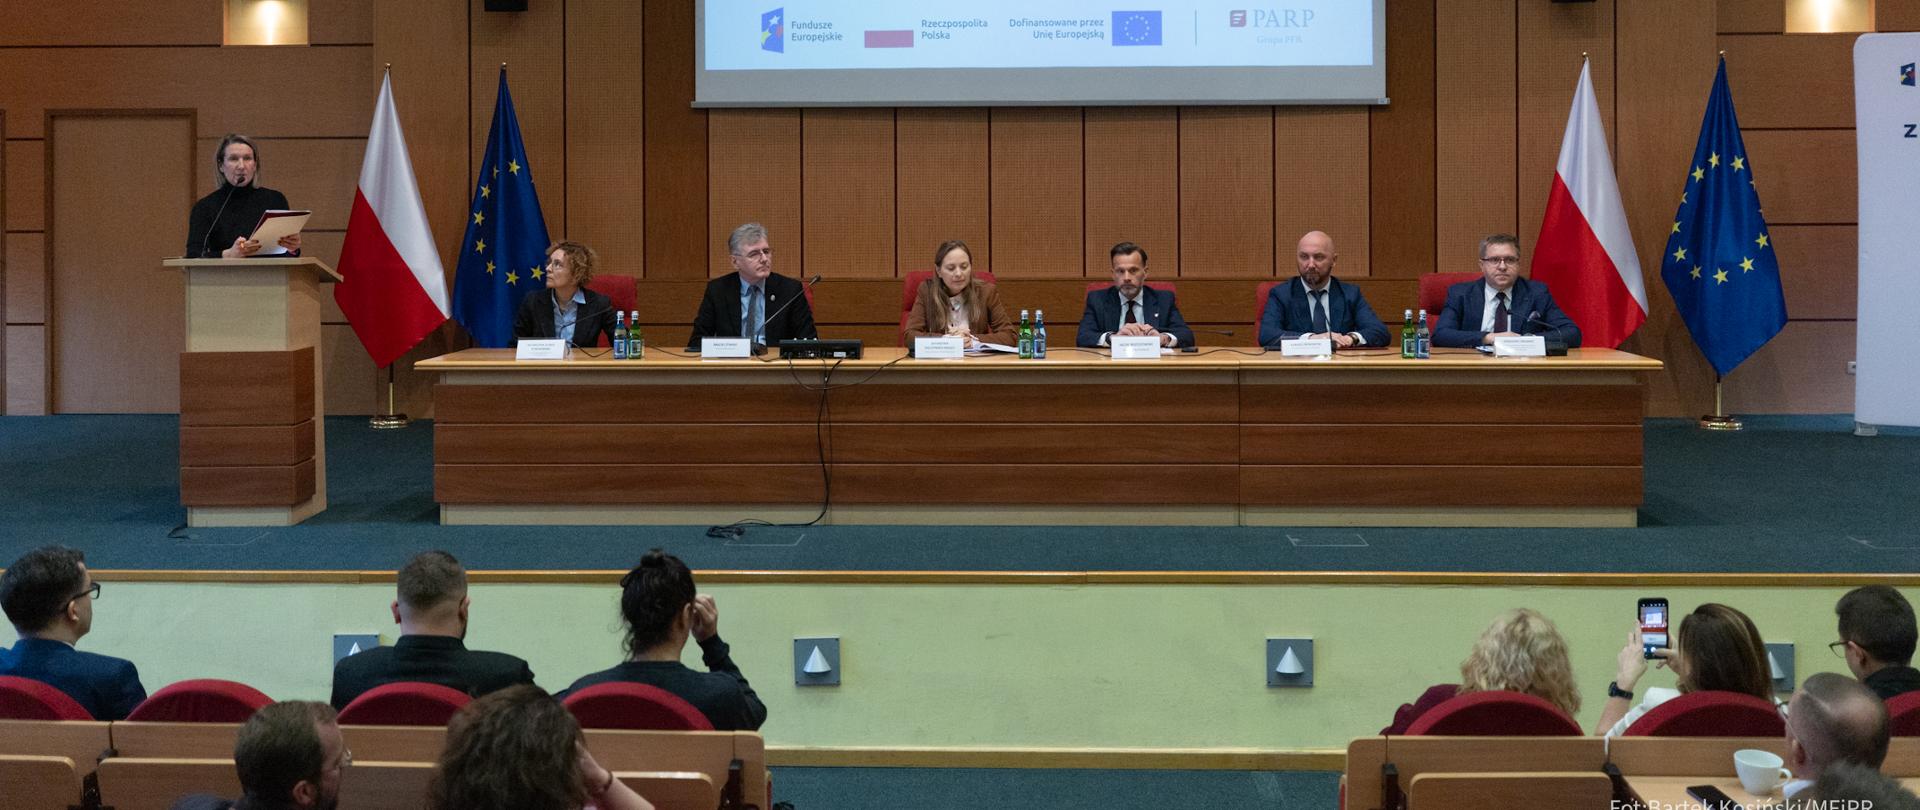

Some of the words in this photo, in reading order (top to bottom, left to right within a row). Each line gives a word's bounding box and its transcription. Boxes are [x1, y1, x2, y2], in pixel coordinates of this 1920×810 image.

[1009, 18, 1078, 28] Dofinansowane
[1080, 19, 1105, 30] przez
[1253, 9, 1315, 28] PARP
[791, 20, 833, 30] Fundusze
[921, 19, 989, 31] Rzeczpospolita
[791, 32, 843, 43] Europejskie
[921, 31, 951, 41] Polska
[1033, 30, 1053, 41] Unię
[1055, 29, 1105, 41] Europejską
